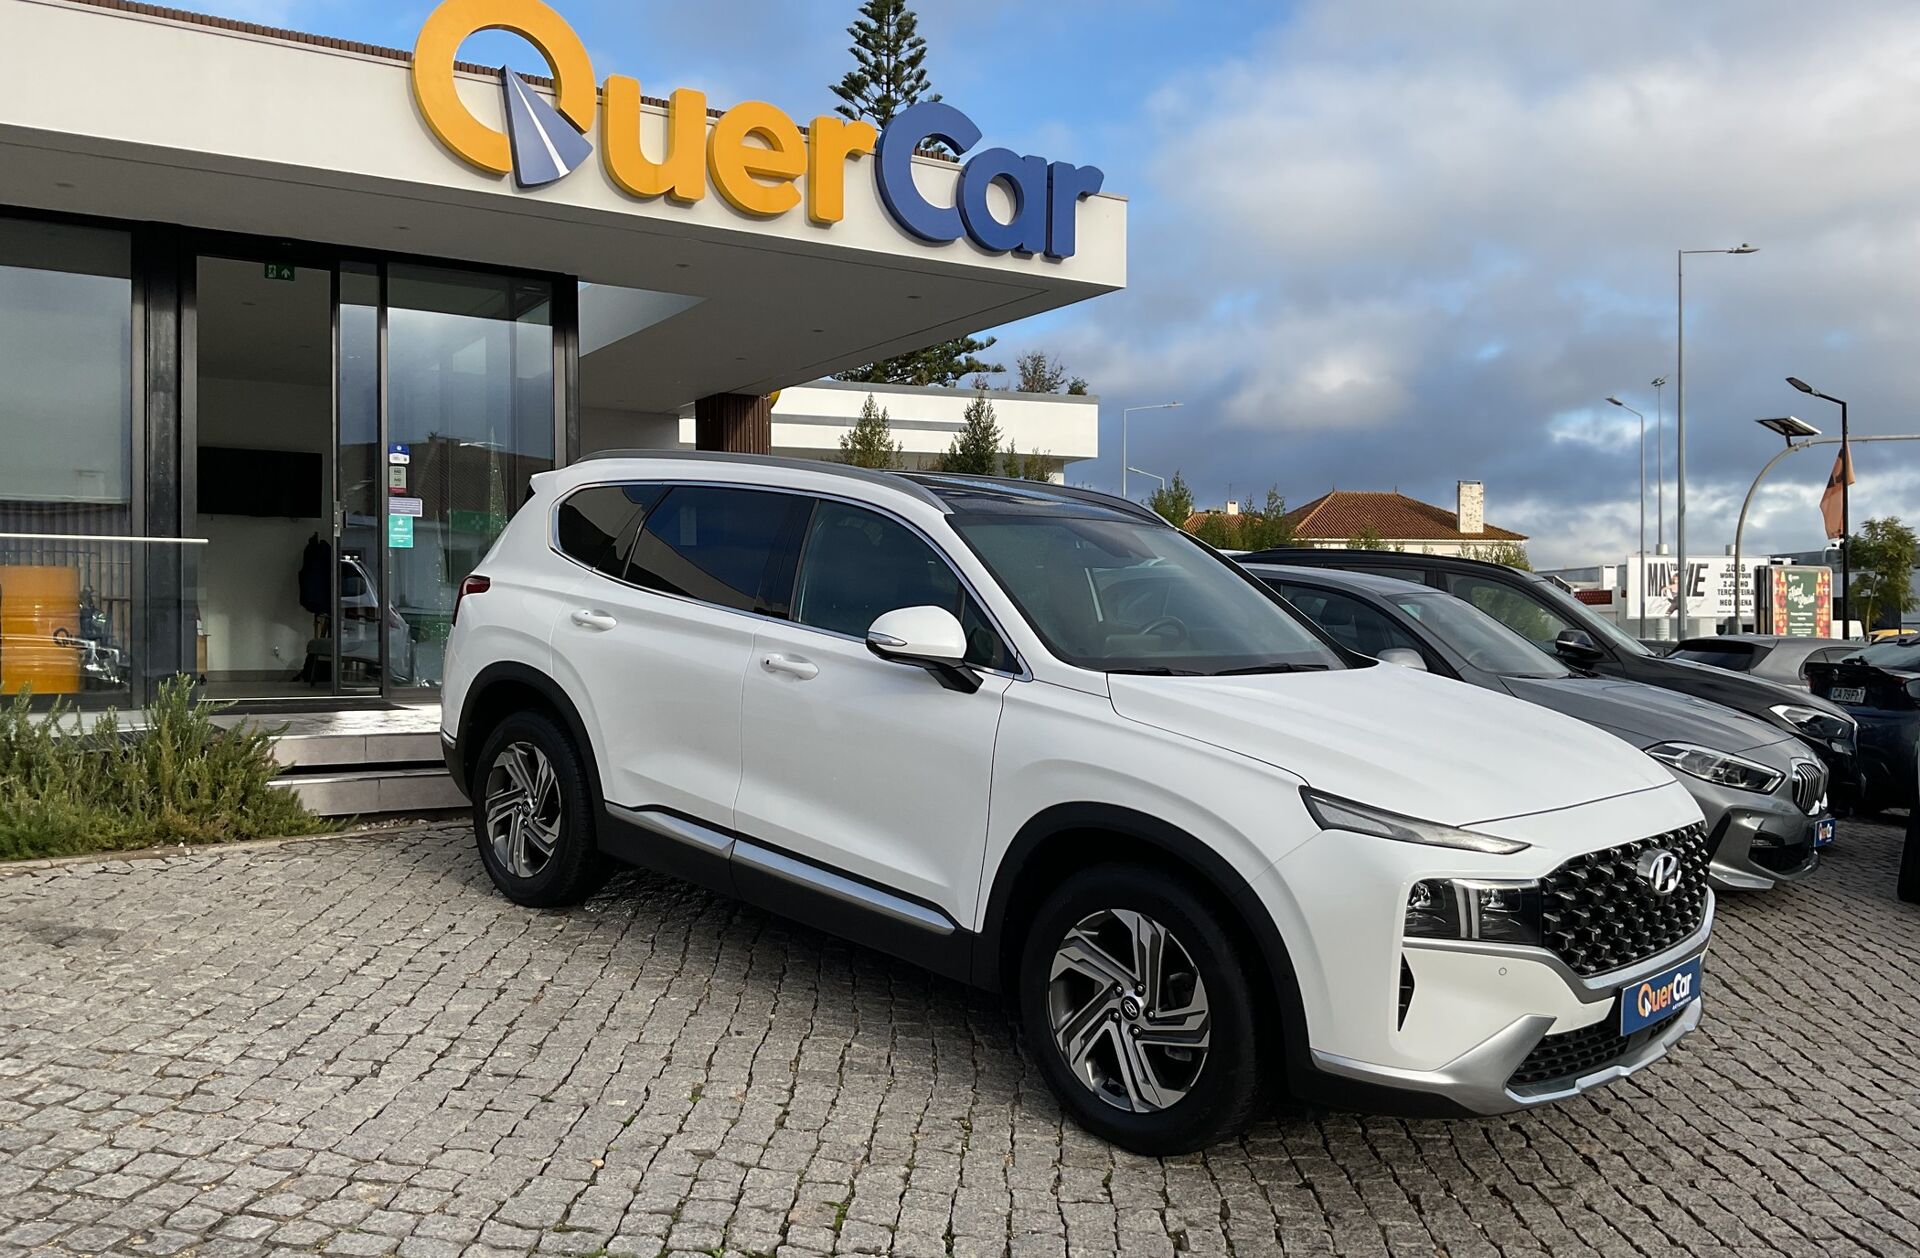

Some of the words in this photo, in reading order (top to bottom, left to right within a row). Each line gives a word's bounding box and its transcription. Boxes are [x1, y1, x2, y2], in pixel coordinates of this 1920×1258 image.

[411, 0, 1105, 259] QuerCar
[1726, 563, 1746, 572] 206
[1637, 972, 1692, 1018] QuerCar
